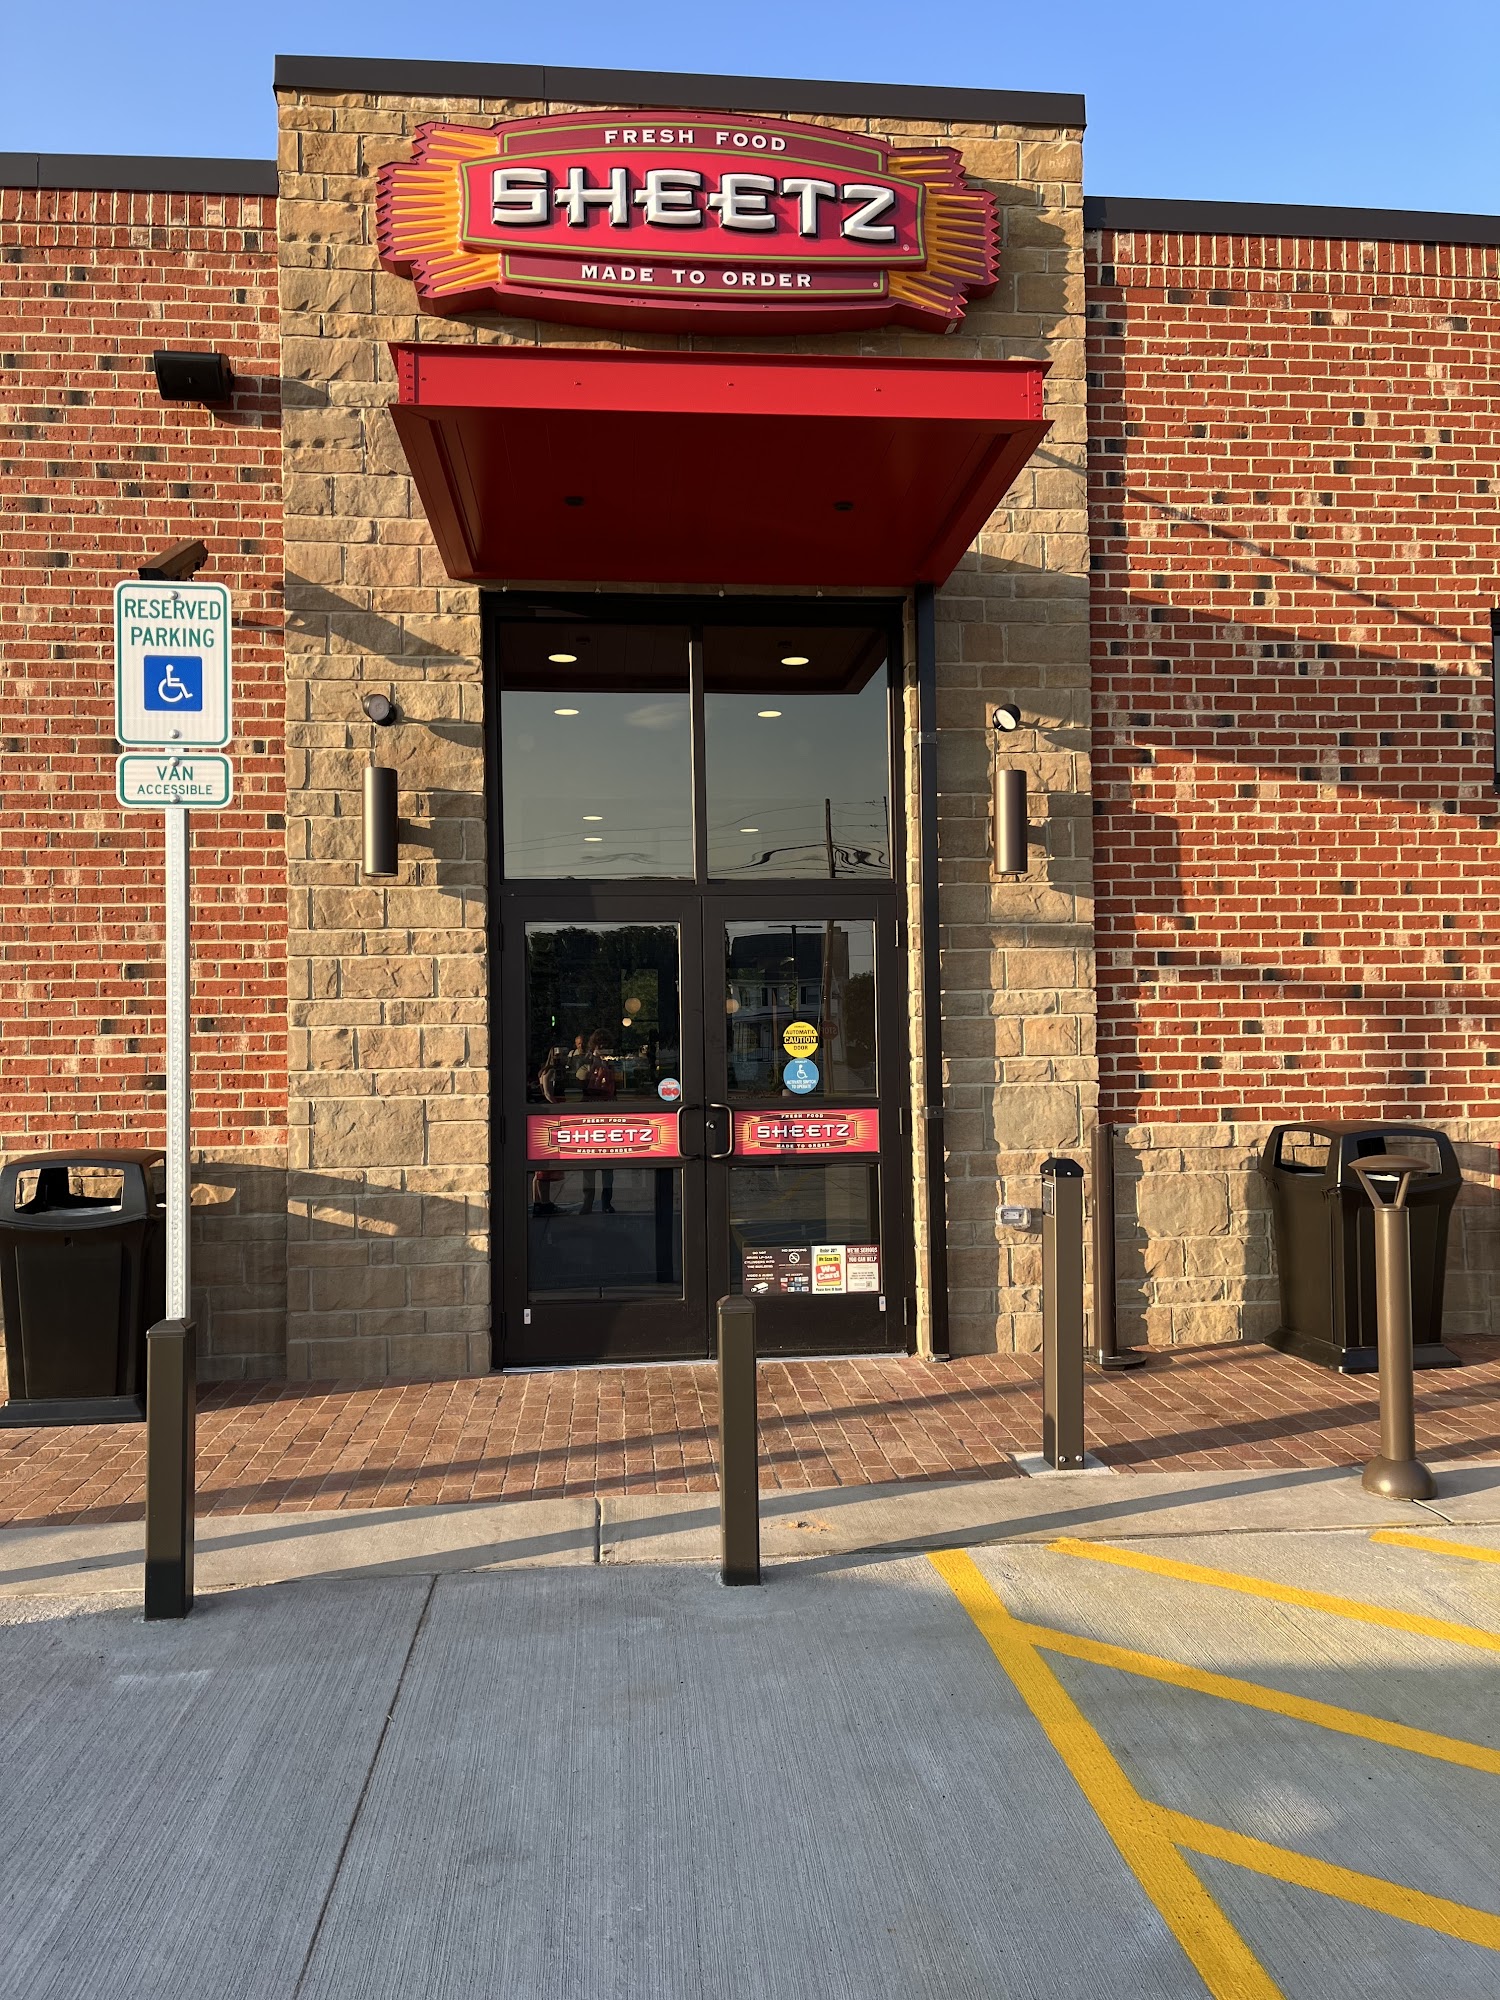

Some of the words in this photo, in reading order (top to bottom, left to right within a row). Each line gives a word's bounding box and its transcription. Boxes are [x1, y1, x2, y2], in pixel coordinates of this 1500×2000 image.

[604, 129, 695, 145] FRESH
[716, 131, 787, 152] FOOD
[492, 167, 896, 243] SHEETZ
[581, 264, 654, 283] MADE
[672, 268, 706, 285] TO
[722, 271, 812, 288] ORDER
[124, 598, 221, 621] RESERVED
[131, 626, 215, 648] PARKING
[156, 766, 194, 781] VAN
[137, 784, 213, 796] ACCESSIBLE
[784, 1036, 817, 1044] CAUTION
[557, 1128, 653, 1143] SHEETZ
[757, 1123, 850, 1138] SHEETZ
[817, 1270, 841, 1281] Card
[820, 1265, 837, 1273] We
